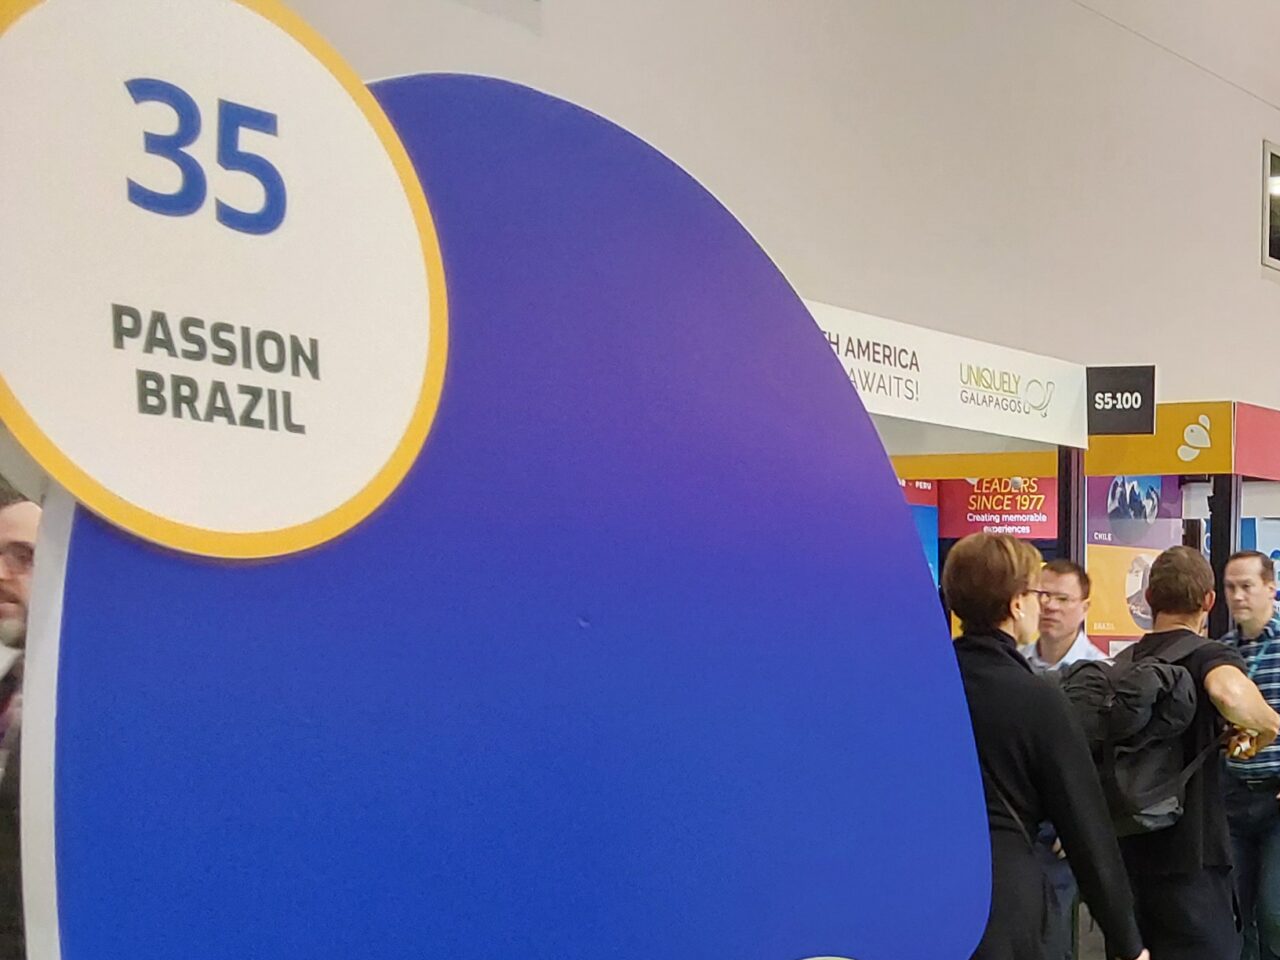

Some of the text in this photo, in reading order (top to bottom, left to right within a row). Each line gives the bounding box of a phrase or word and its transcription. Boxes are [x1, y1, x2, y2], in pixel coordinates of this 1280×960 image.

[124, 77, 287, 236] 35
[111, 302, 321, 380] PASSION
[844, 336, 921, 373] AMERICA
[848, 367, 920, 402] AWAITS!
[959, 362, 1021, 395] UNIQUELY
[135, 368, 307, 435] BRAZIL
[960, 389, 1023, 414] GALAPAGOS
[1094, 392, 1142, 410] S5-100
[967, 512, 1047, 523] Creating memorable
[968, 495, 1045, 511] SINCE 1977
[983, 524, 1030, 535] experiences
[1093, 531, 1112, 542] CHILE
